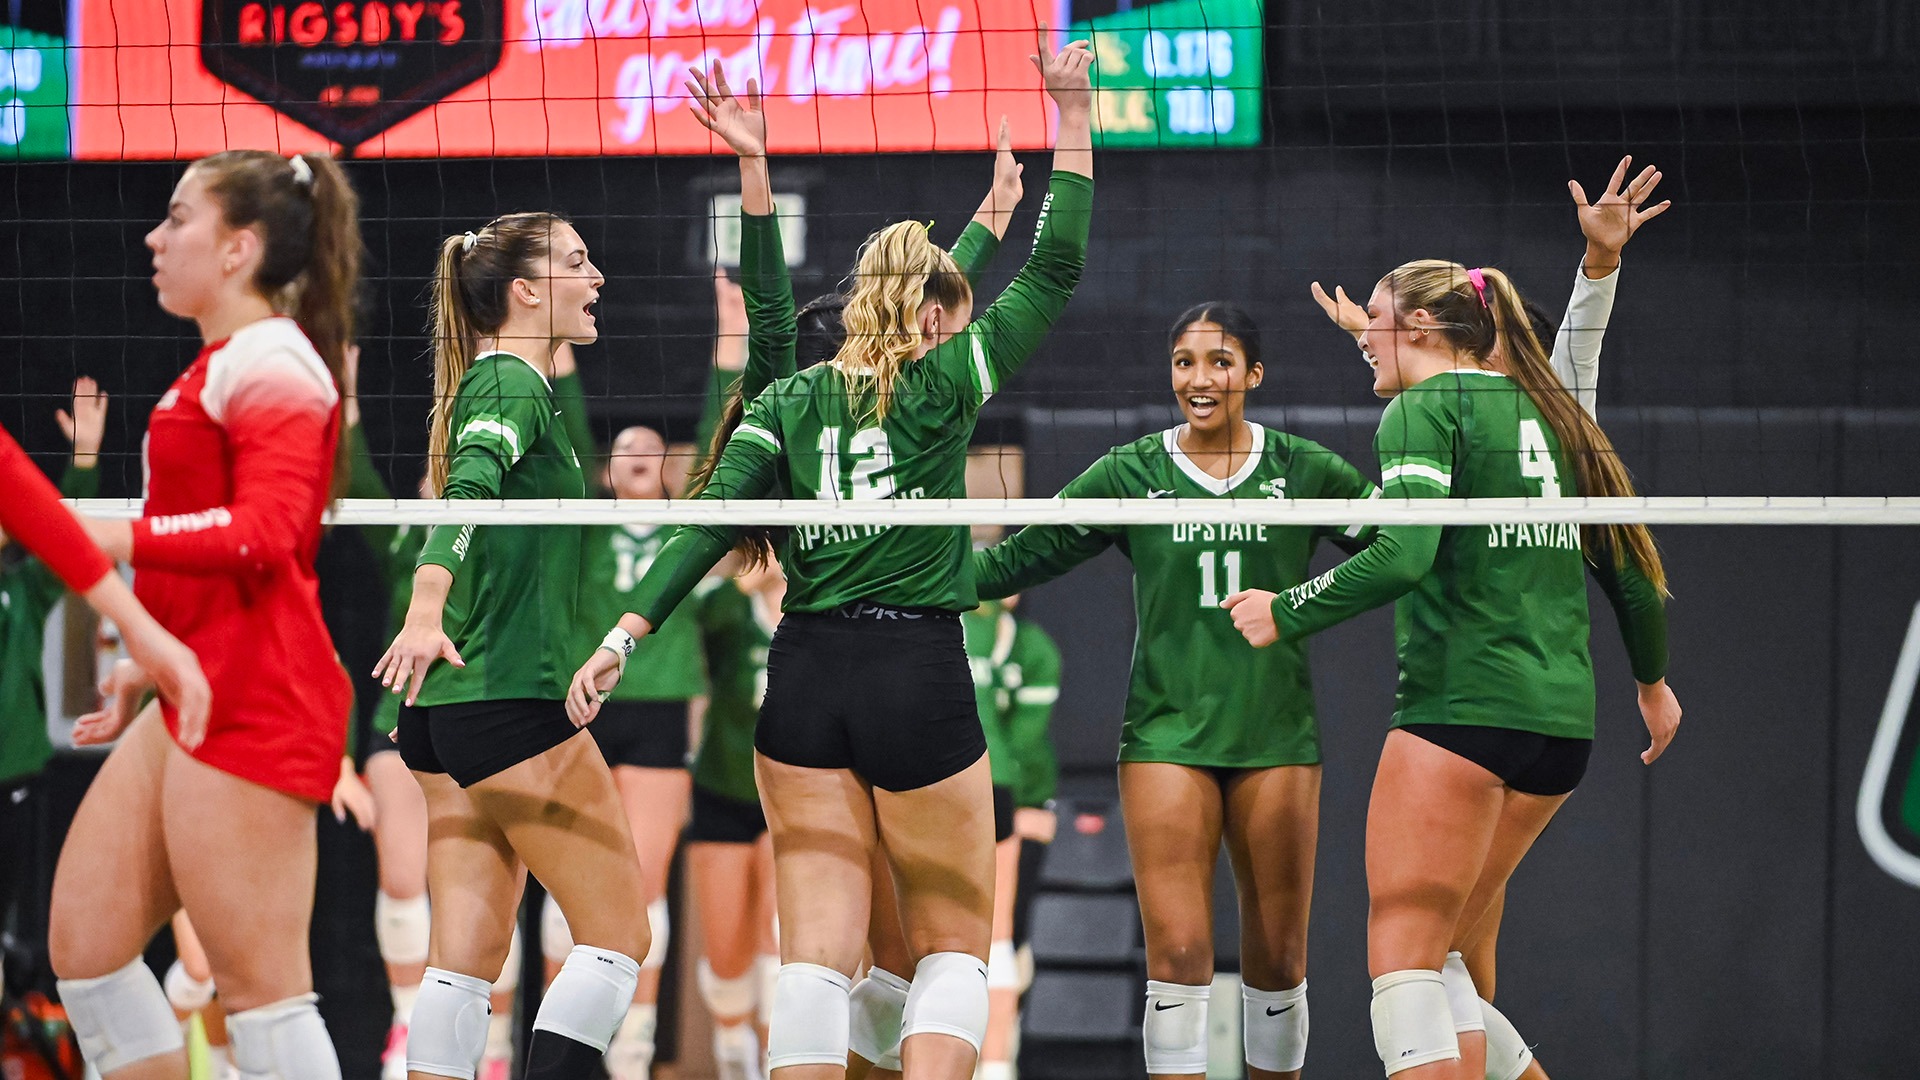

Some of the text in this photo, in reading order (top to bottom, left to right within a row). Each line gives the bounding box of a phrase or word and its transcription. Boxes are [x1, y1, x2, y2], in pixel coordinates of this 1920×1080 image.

[238, 2, 465, 47] RIGSBY'S
[816, 426, 898, 500] 12
[1519, 418, 1561, 497] 4
[1487, 522, 1582, 551] SPARTAN
[1198, 550, 1241, 607] 11
